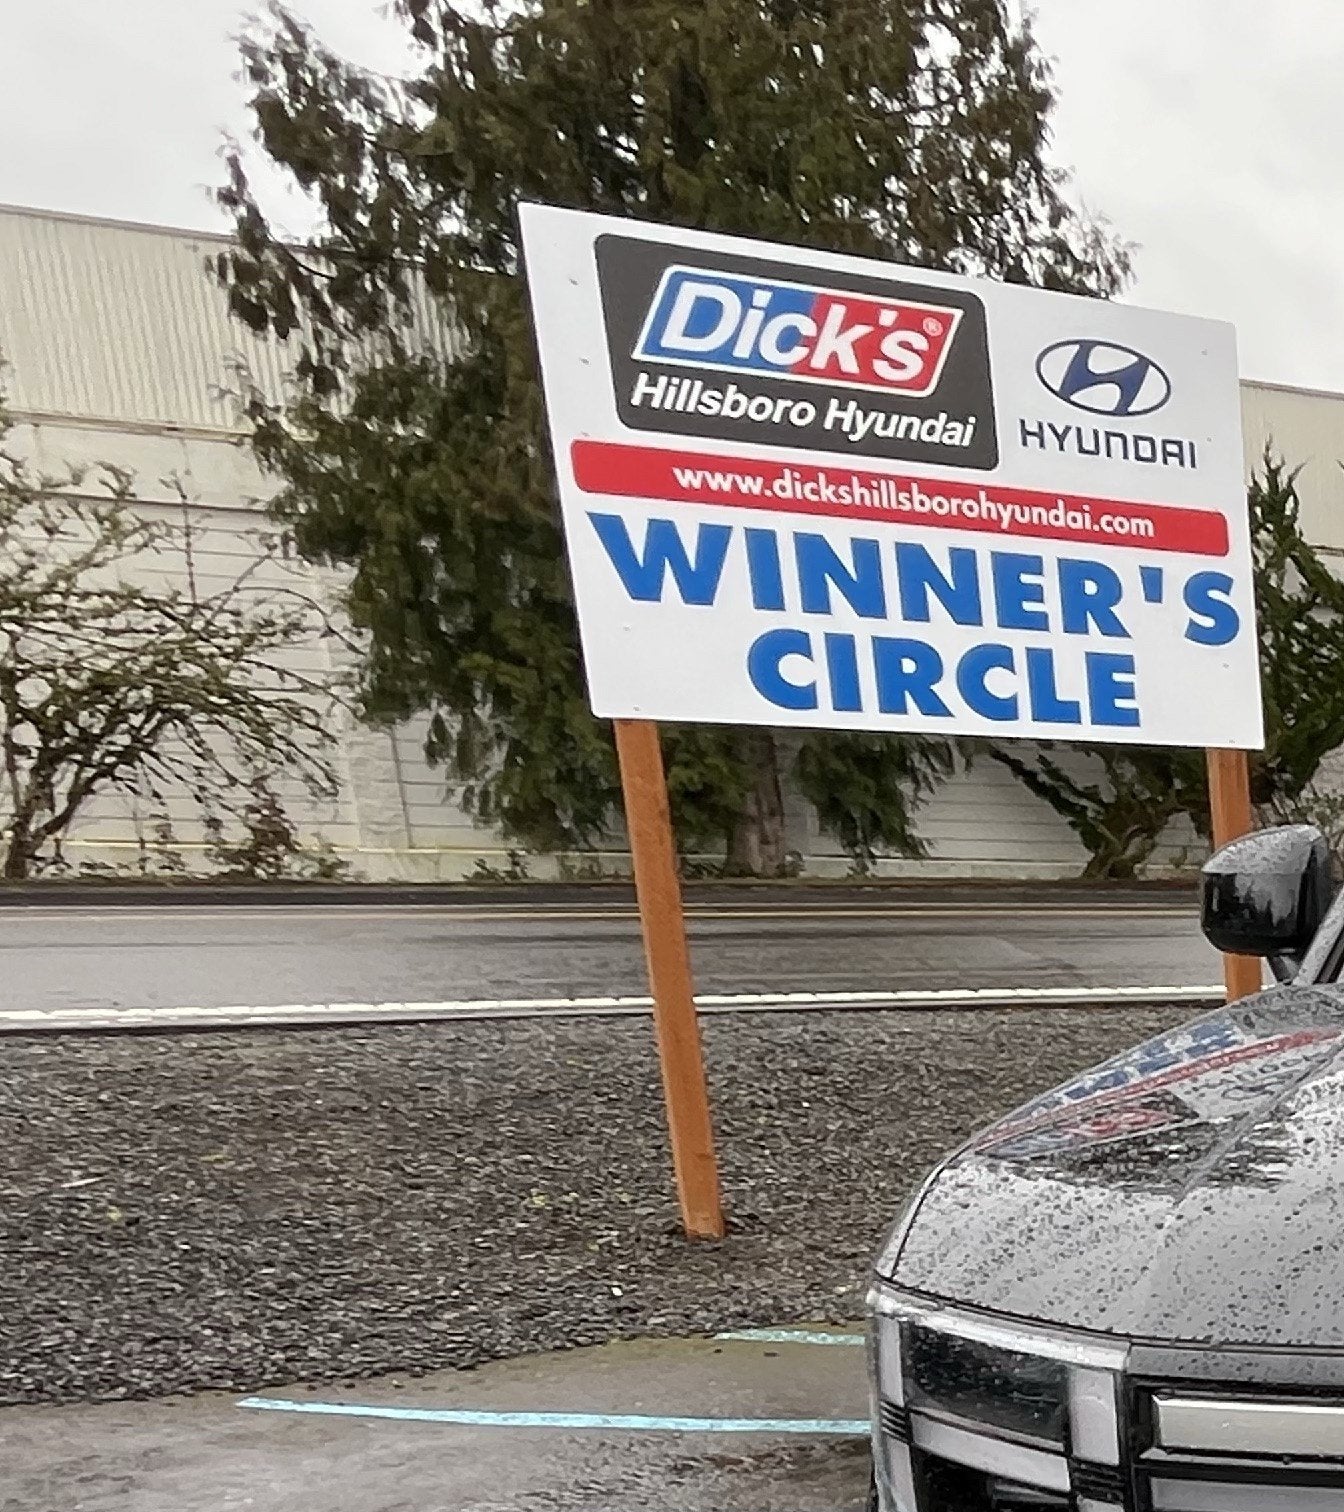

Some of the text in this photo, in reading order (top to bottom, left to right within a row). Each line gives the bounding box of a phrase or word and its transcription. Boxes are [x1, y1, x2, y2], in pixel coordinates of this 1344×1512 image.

[661, 280, 930, 383] Dick's
[630, 372, 977, 448] Hillsboro Hyundai
[1020, 418, 1197, 469] HYUNDAI
[673, 464, 1154, 539] www.dickshillsborohyundai.com
[587, 512, 1241, 646] WINNER'S
[747, 628, 1142, 727] CIRCLE
